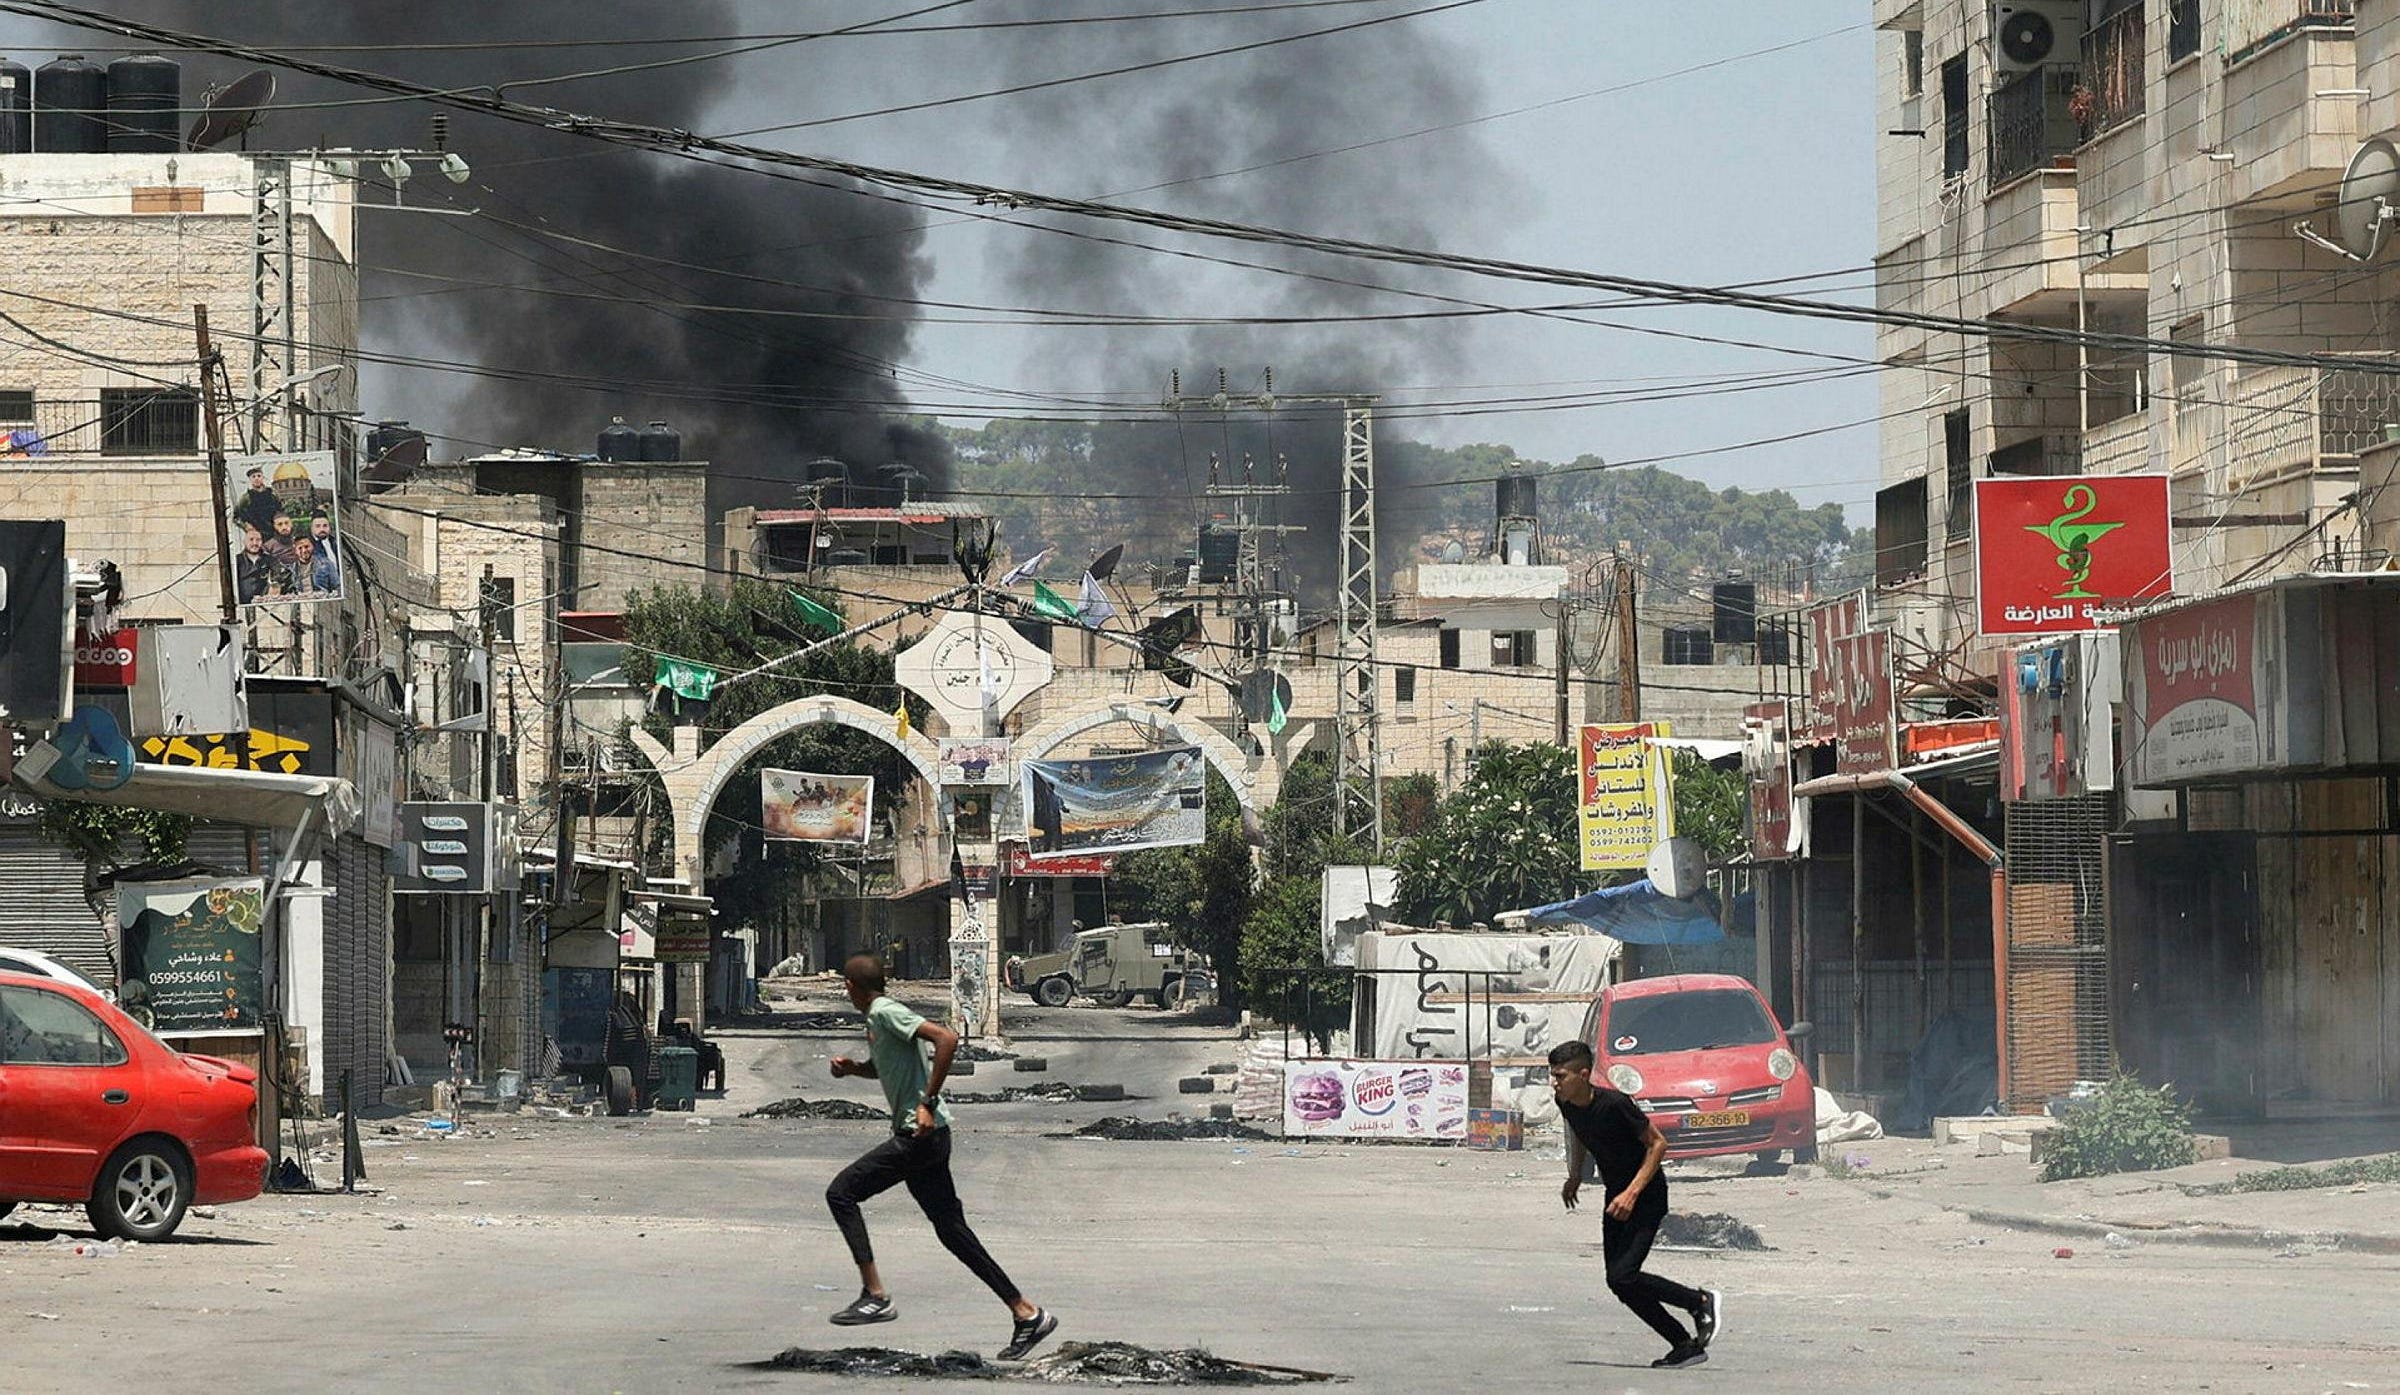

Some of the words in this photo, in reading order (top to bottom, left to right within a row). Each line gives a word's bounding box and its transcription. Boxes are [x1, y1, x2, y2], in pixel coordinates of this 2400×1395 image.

[2004, 604, 2074, 625] العارضة
[946, 670, 971, 687] جنين
[1594, 731, 1640, 752] معرض
[1587, 800, 1654, 821] والمفروشات
[149, 970, 221, 984] 0599554661
[1356, 1075, 1393, 1094] BURGER
[1358, 1084, 1394, 1105] KING
